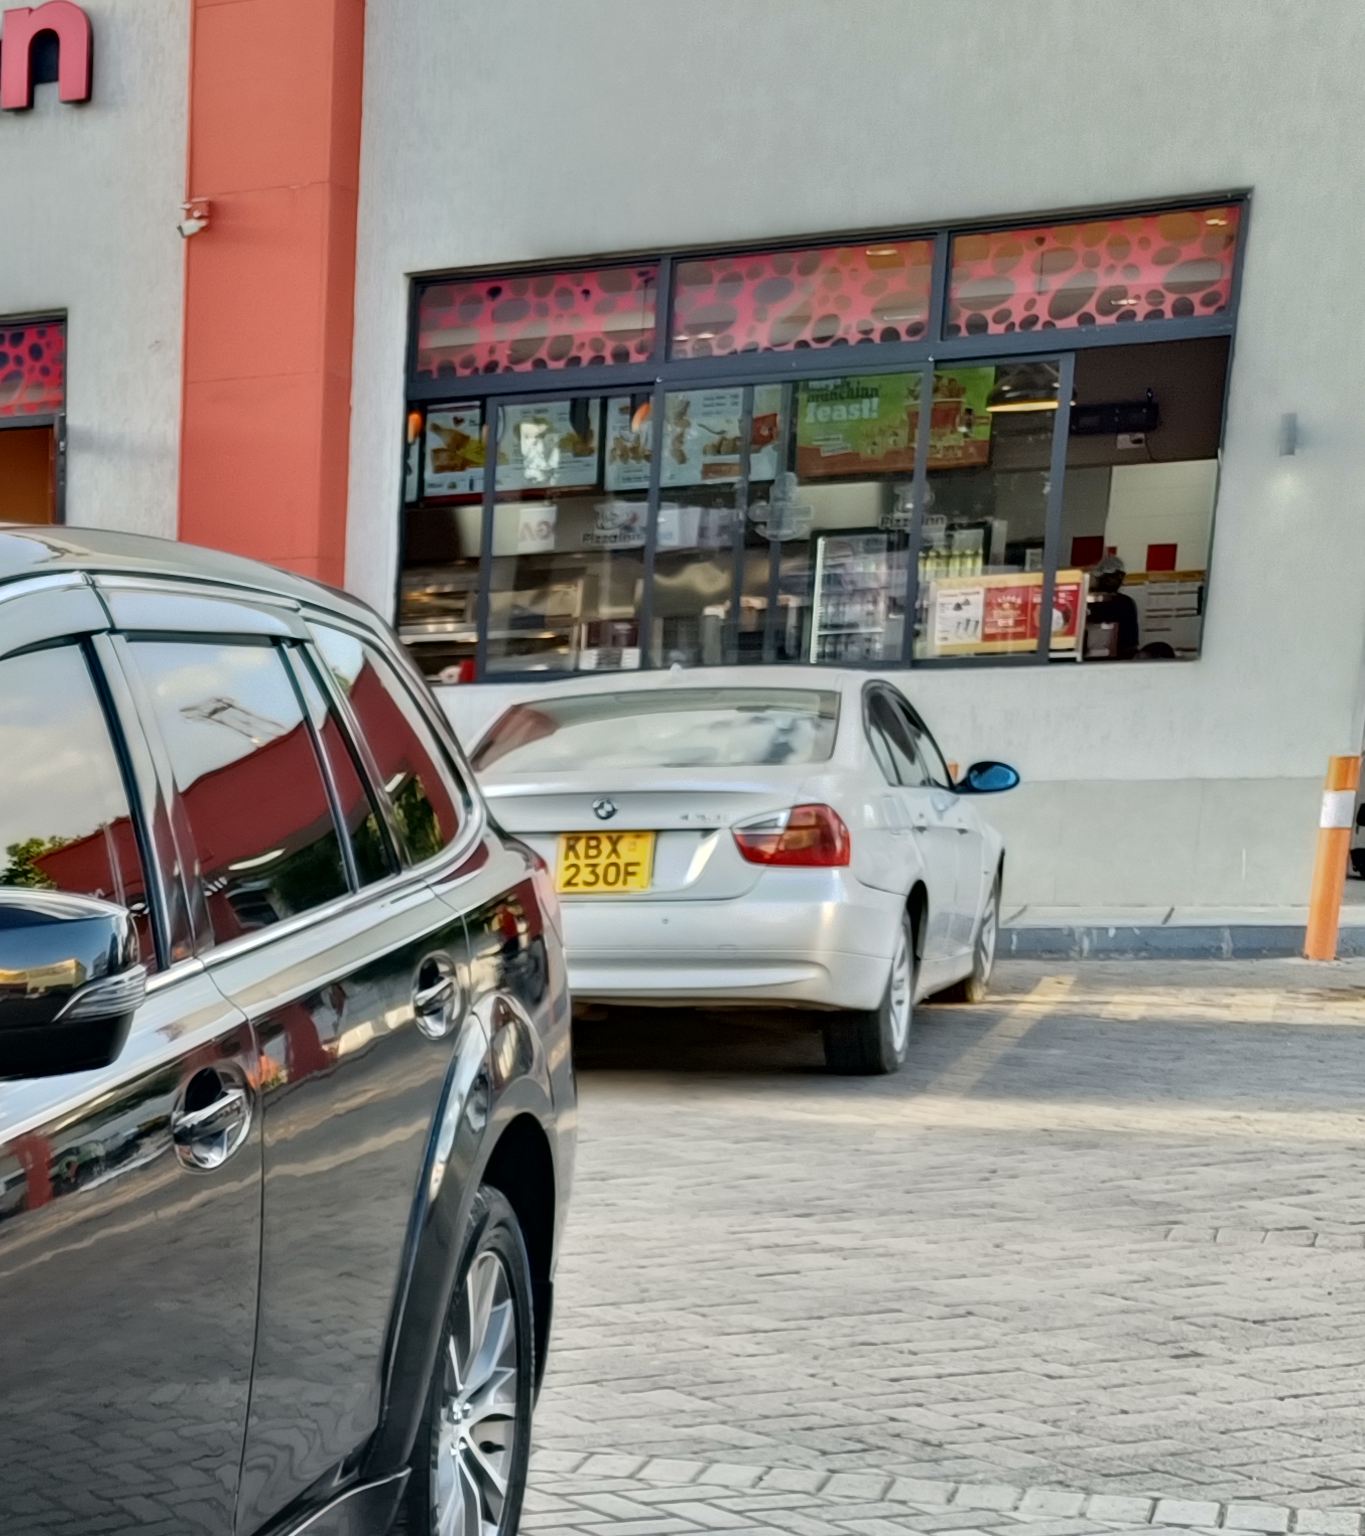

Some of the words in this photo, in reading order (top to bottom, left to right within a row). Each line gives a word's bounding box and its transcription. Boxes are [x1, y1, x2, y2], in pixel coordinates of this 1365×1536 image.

[804, 397, 880, 424] feast!
[563, 834, 625, 861] KBX
[562, 861, 641, 889] 230F
